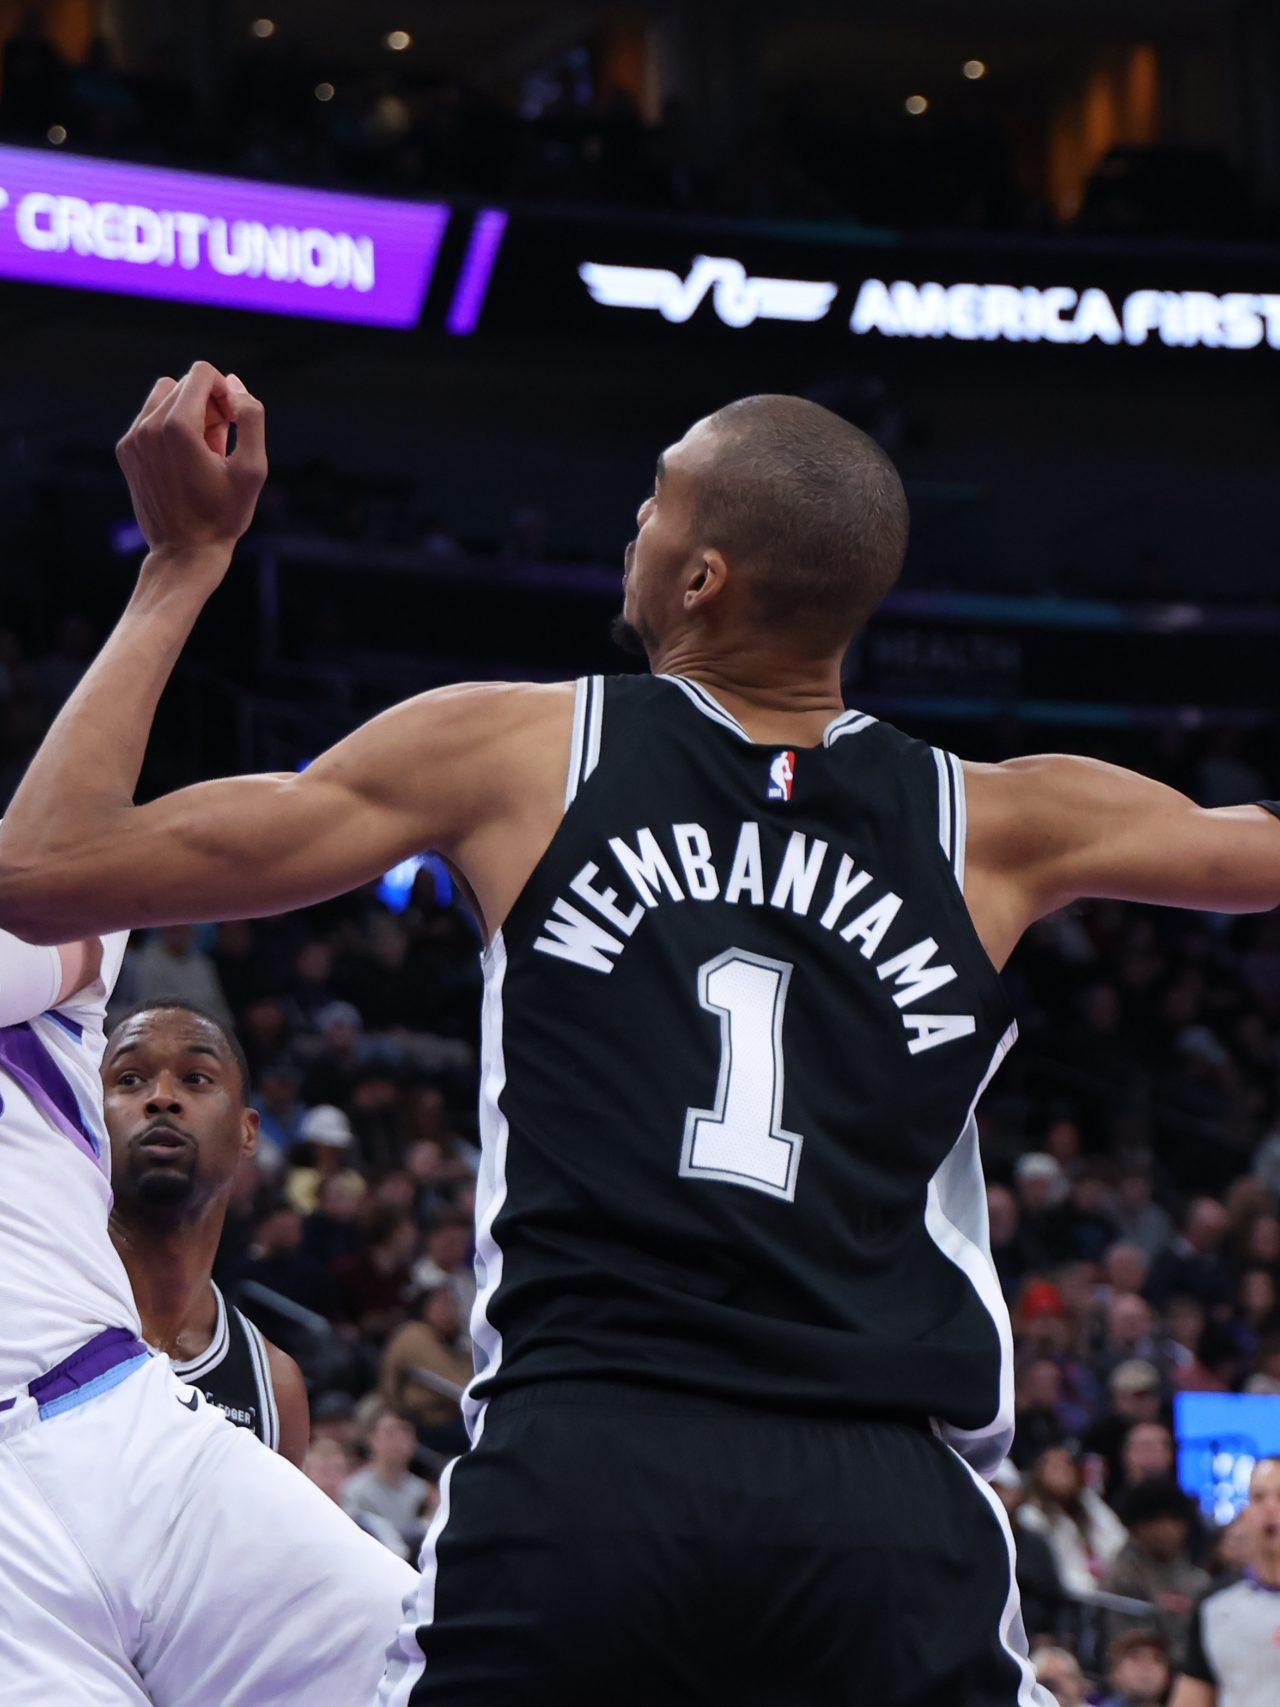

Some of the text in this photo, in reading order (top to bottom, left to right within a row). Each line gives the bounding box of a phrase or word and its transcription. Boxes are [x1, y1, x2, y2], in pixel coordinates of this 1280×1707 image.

[16, 191, 210, 270] CREDIT
[209, 217, 375, 293] UNION
[849, 278, 1122, 345] AMERICA
[532, 821, 977, 1056] WEMBANYAMA
[678, 946, 804, 1203] 1
